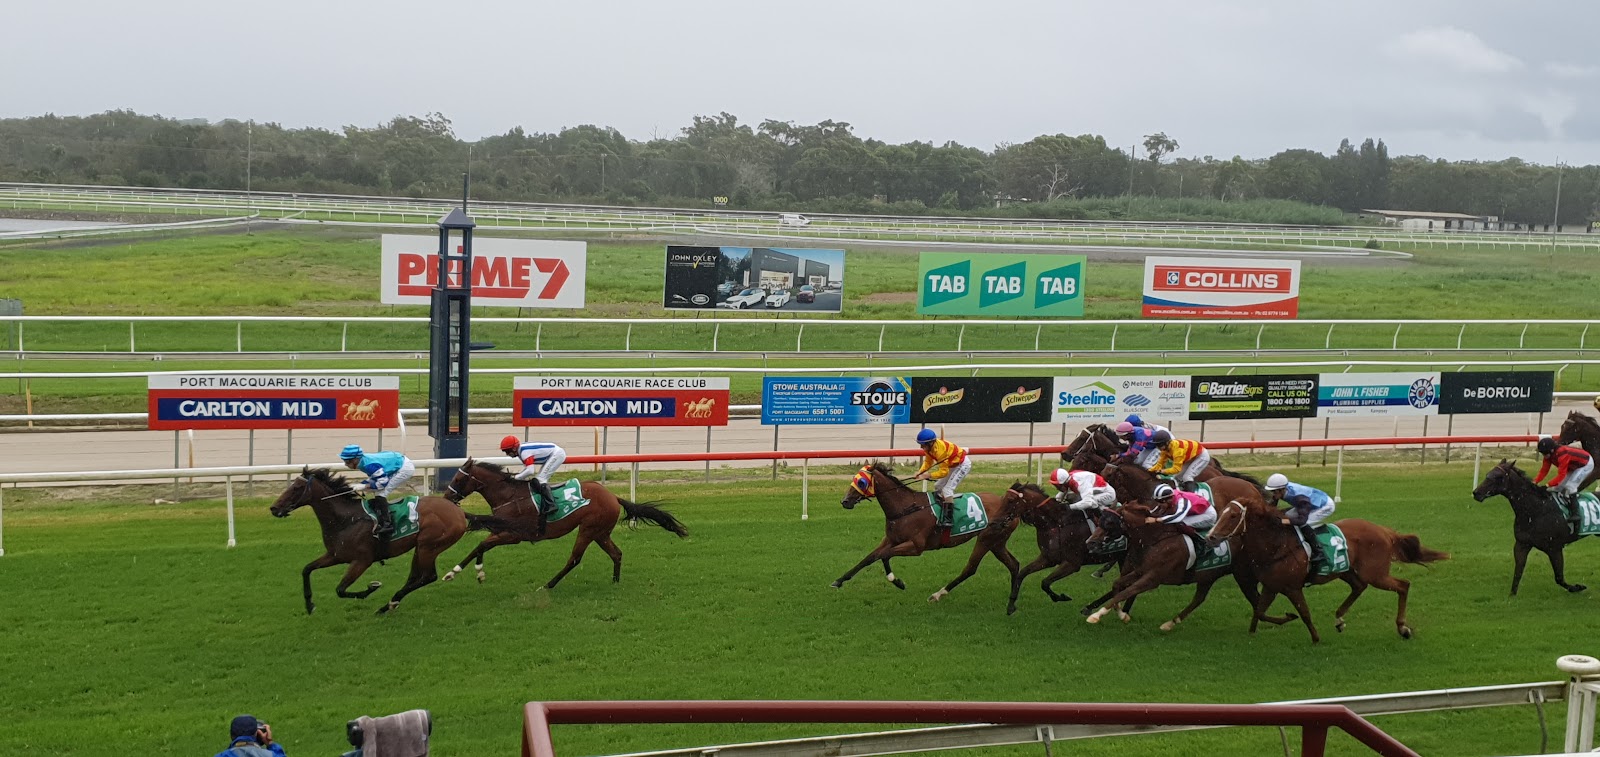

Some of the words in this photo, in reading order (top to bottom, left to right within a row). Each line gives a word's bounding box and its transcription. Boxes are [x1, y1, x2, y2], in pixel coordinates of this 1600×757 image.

[713, 196, 728, 204] 1000
[928, 275, 965, 293] TAB
[985, 276, 1021, 294] TAB
[1040, 277, 1075, 295] TAB
[1185, 272, 1279, 289] COLLINS
[180, 377, 215, 387] PORT
[219, 377, 296, 388] MACQUARIE
[301, 378, 335, 387] RACE
[339, 378, 372, 387] CLUB
[541, 378, 572, 388] PORT
[575, 379, 641, 389] MACQUARIE
[645, 379, 674, 388] RACE
[677, 379, 707, 388] CLUB
[1158, 380, 1186, 389] Buildex
[1410, 380, 1433, 396] PLUMBING
[853, 392, 905, 405] STOWE
[926, 393, 960, 407] Schweppes
[1005, 393, 1037, 406] Schweppes
[1058, 390, 1116, 406] Steeline
[1331, 387, 1353, 398] JOHN
[1354, 387, 1359, 397] L
[1361, 387, 1390, 397] FISHER
[179, 400, 270, 417] CARLTON
[281, 402, 323, 416] MID
[538, 400, 617, 415] CARLTON
[627, 401, 662, 414] MID
[966, 496, 983, 521] 4
[1579, 500, 1600, 526] 10
